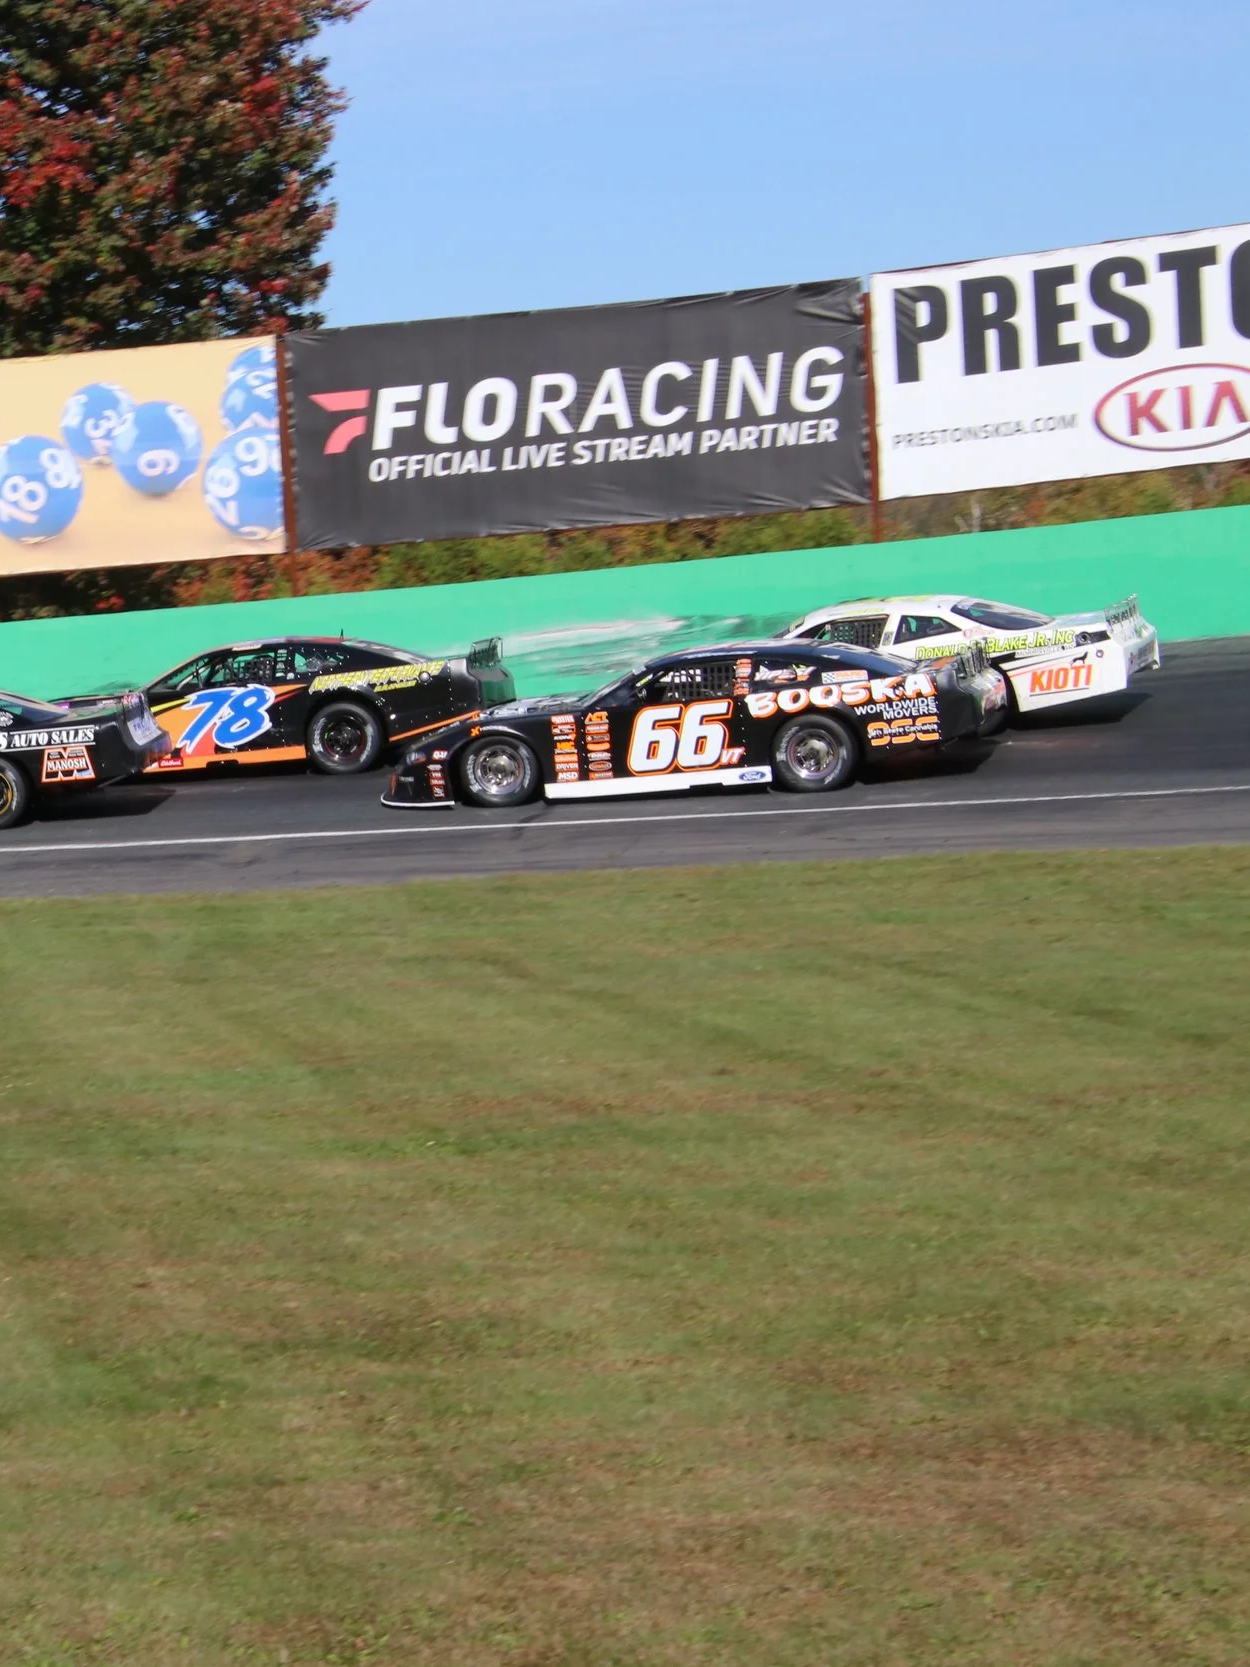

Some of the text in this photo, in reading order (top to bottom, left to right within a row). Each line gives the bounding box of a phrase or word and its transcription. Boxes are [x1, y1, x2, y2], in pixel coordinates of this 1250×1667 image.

[372, 345, 845, 453] FLORACING
[1122, 380, 1248, 437] KIA
[892, 412, 1078, 450] PRESTONSKIA.COM
[367, 417, 840, 483] OFFICIAL LIVE STREAM PARTNER
[987, 635, 1027, 653] BLAKE
[1029, 664, 1092, 694] KIOTI
[176, 684, 276, 754] 78
[854, 696, 936, 715] WORLDWIDE
[882, 705, 937, 720] MOVERS
[11, 731, 49, 748] AUTO
[51, 728, 95, 745] SALES
[627, 699, 733, 776] 66
[720, 748, 744, 766] VT
[46, 757, 87, 771] MANOSH
